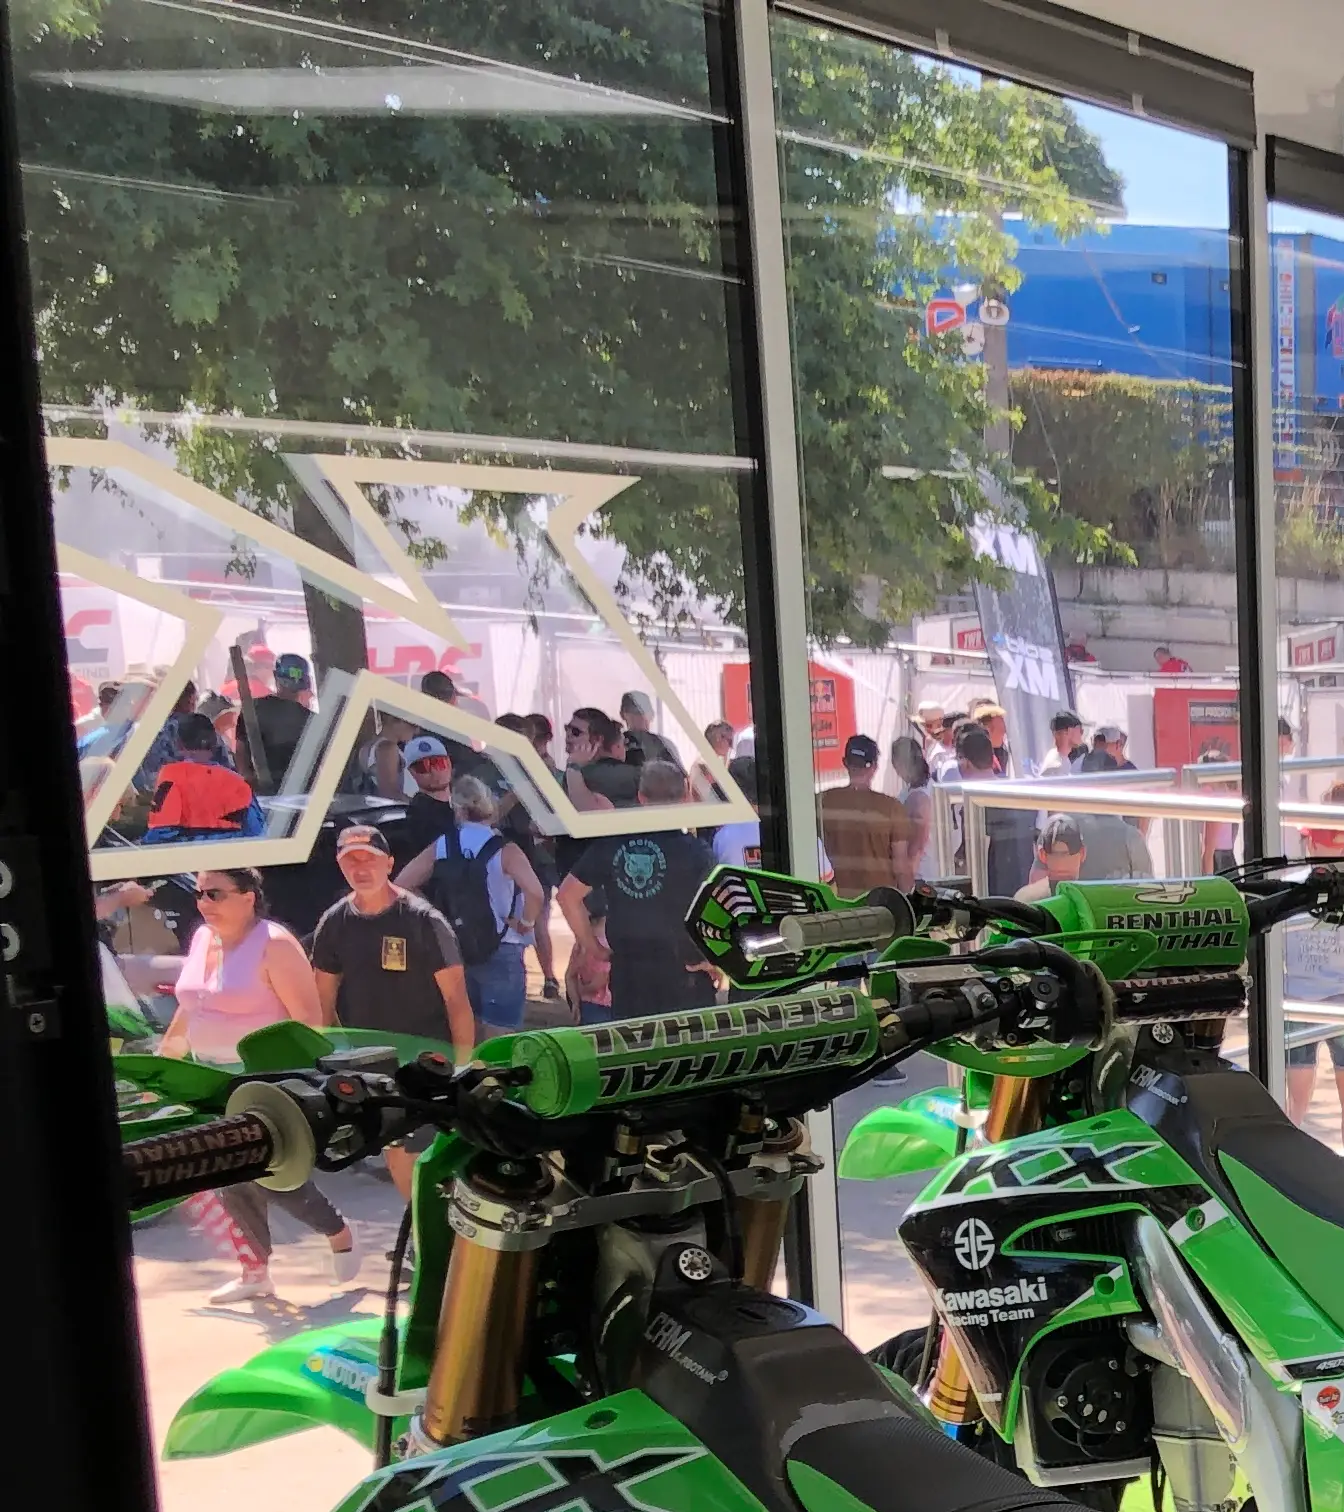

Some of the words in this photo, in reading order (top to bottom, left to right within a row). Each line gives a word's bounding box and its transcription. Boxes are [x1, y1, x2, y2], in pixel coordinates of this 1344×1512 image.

[1106, 908, 1241, 930] RENTHAL
[580, 991, 857, 1056] RENTHAL
[600, 1030, 870, 1098] RENTHAL
[934, 1275, 1048, 1313] Kawasaki
[989, 1307, 1035, 1323] Team
[322, 1351, 370, 1391] MOTOR
